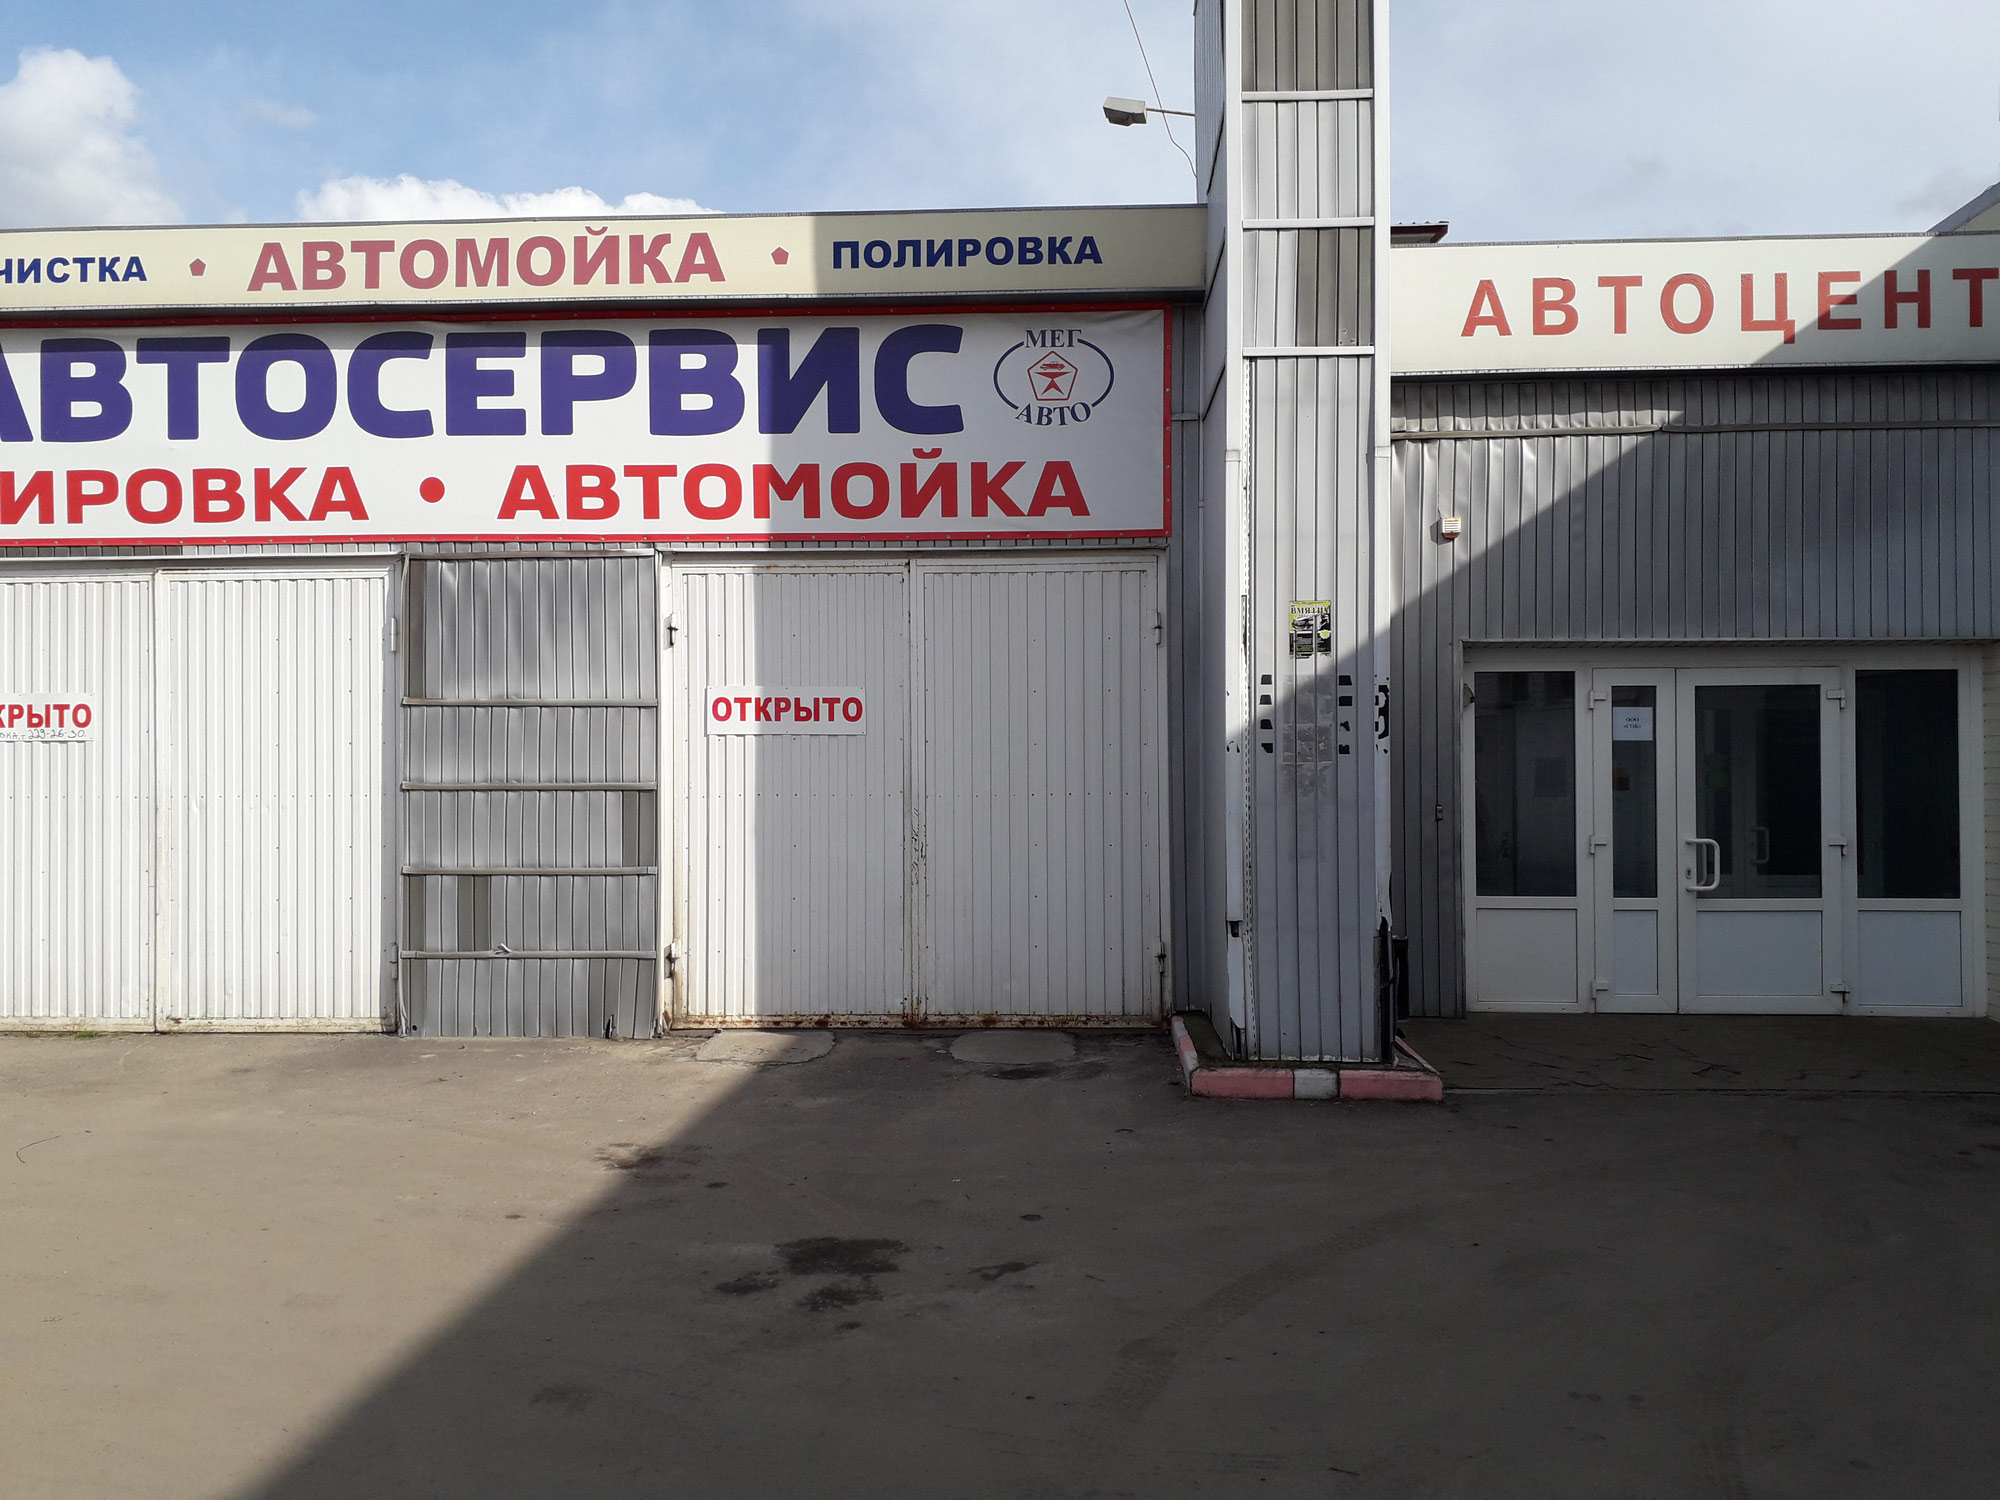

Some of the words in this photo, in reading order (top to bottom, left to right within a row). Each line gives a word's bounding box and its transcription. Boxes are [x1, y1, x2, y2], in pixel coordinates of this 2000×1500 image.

[248, 226, 725, 291] АВТОМОЙКА
[832, 235, 1103, 269] ПОЛИРОВКА
[1460, 267, 1999, 344] АВТОЦЕНТ
[1025, 329, 1082, 348] МЕГ
[1015, 402, 1091, 426] АВТО
[0, 467, 370, 525] ИРОВКА
[498, 447, 1090, 521] АВТОМОЙКА
[712, 696, 863, 722] ОТКРЫТО
